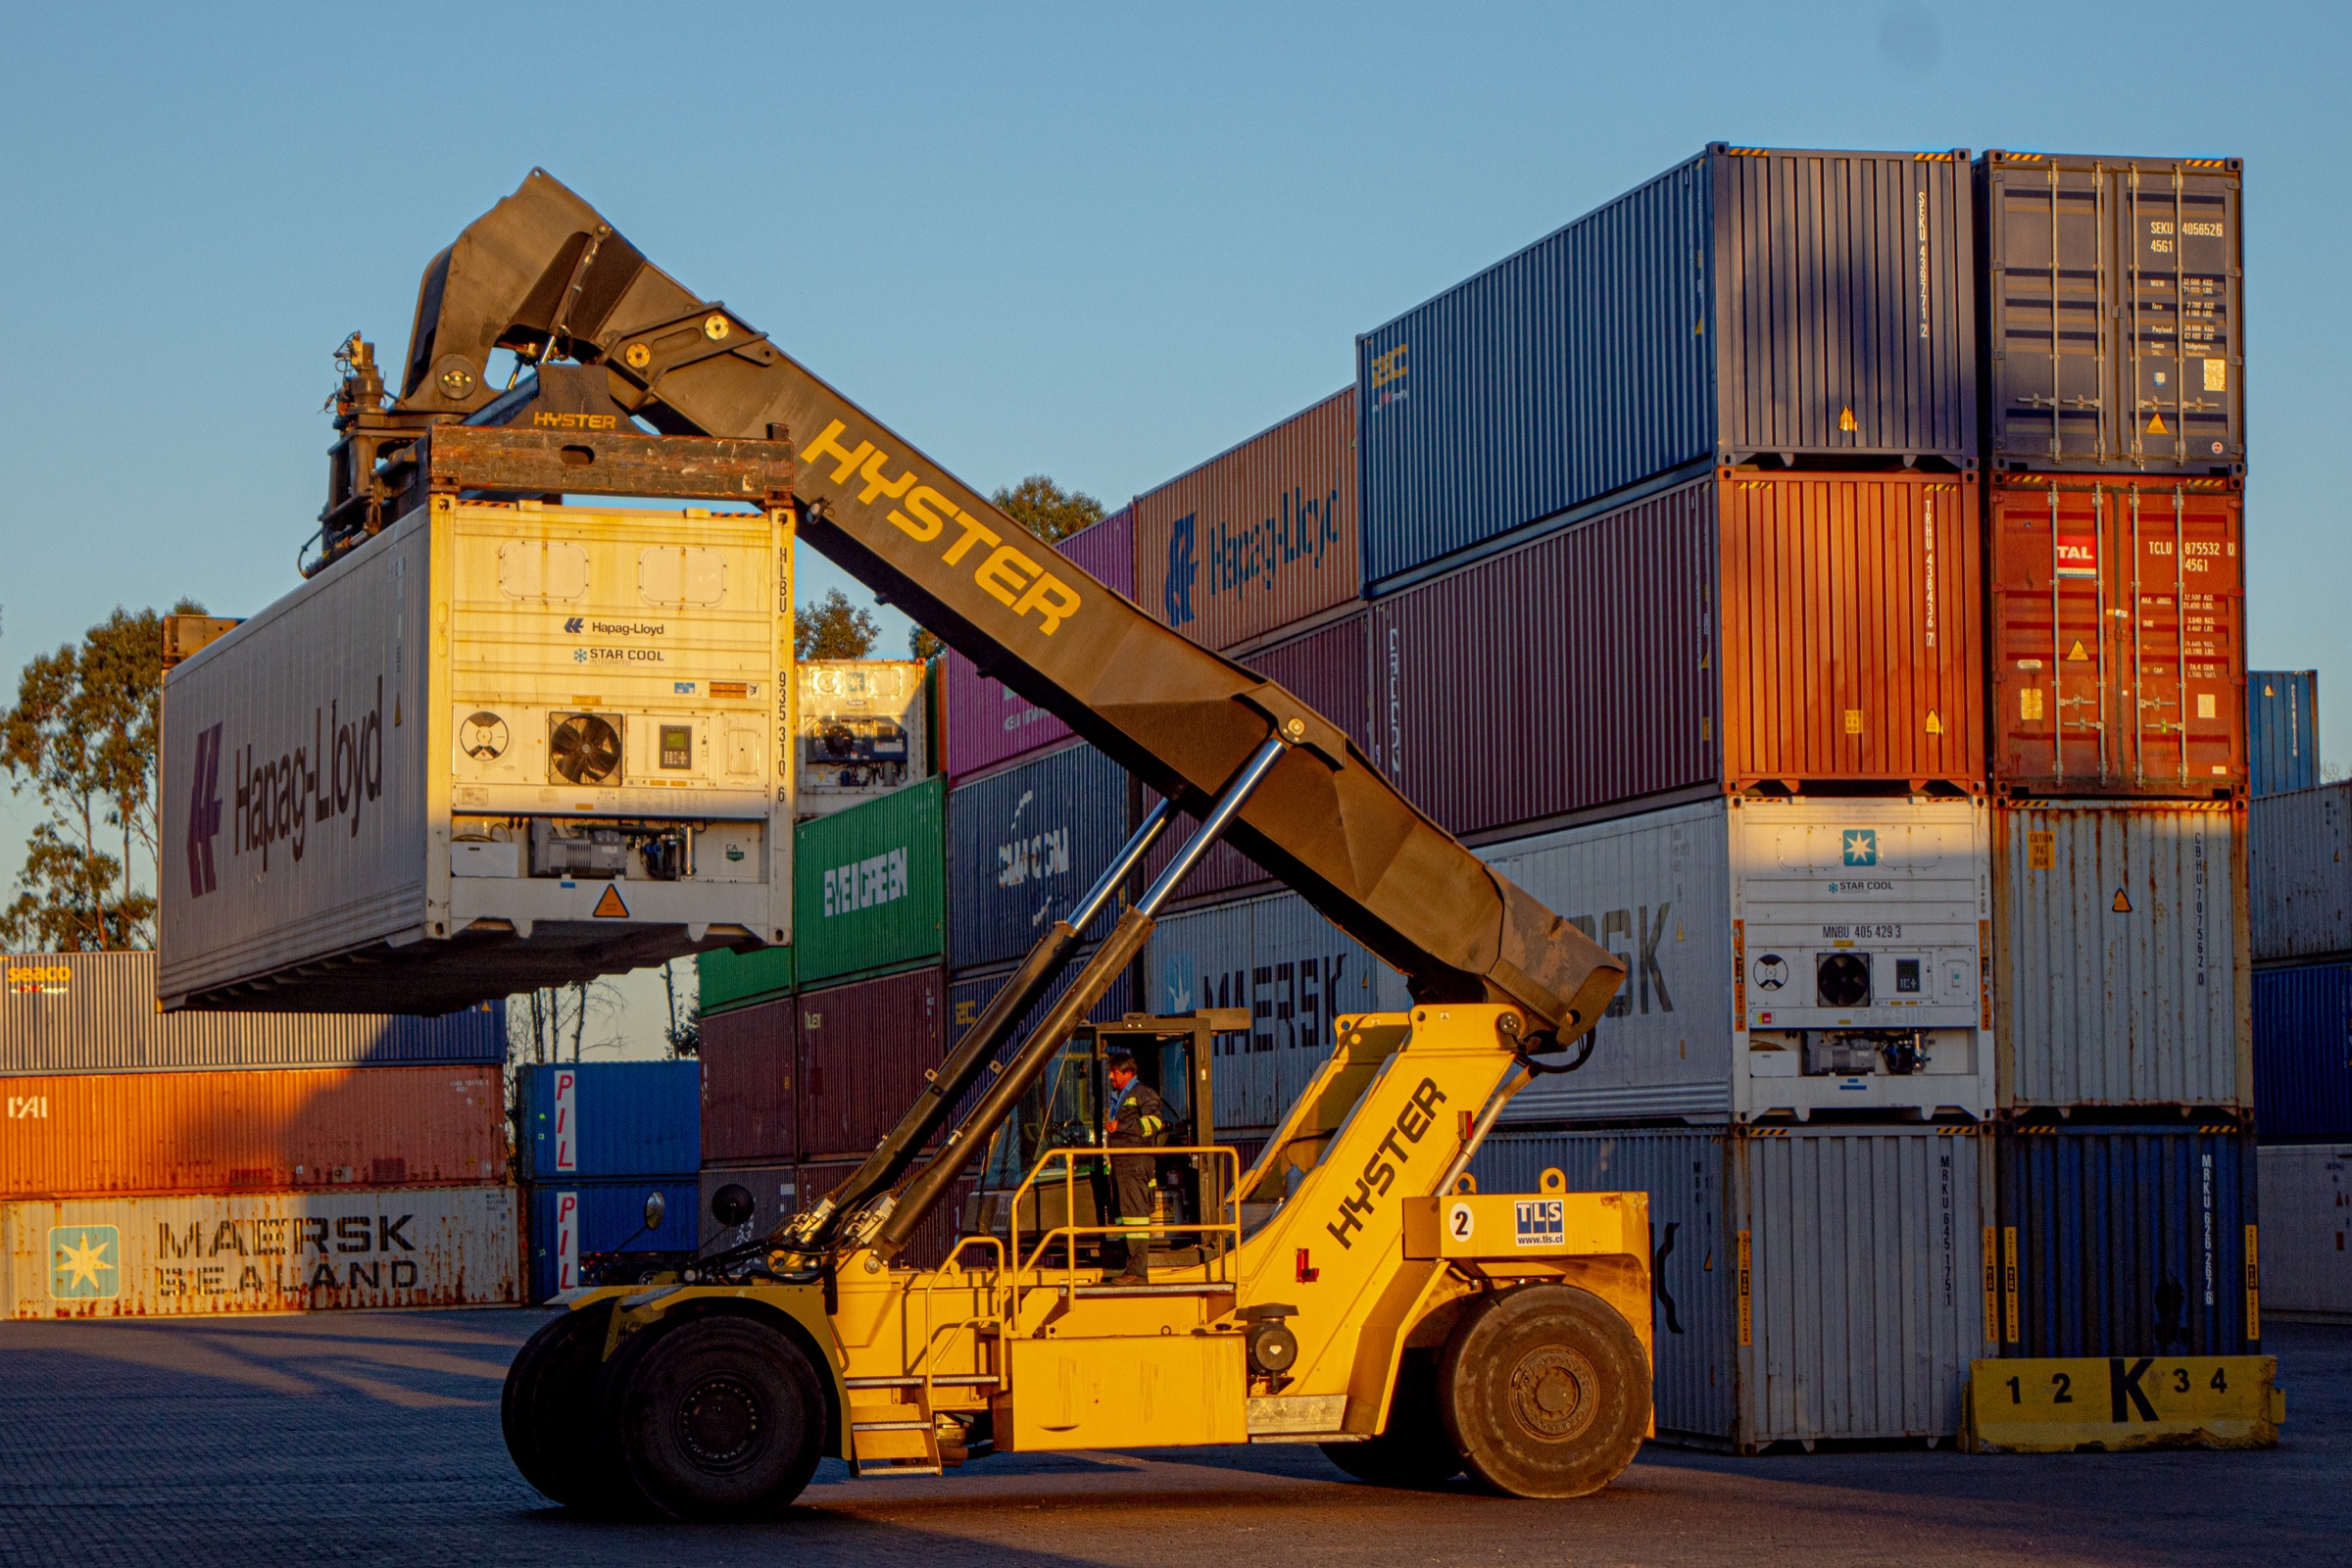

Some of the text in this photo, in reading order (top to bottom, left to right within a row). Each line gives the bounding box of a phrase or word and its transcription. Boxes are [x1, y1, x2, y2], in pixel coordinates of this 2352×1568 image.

[2150, 221, 2174, 234] SEKU
[2150, 239, 2173, 253] 45G1
[2152, 325, 2173, 334] Payload
[533, 412, 617, 429] HYSTER
[800, 417, 1082, 637] HYSTER
[1209, 486, 1341, 601] Hapag-Lloyd
[2057, 546, 2093, 560] TAL
[2148, 541, 2173, 555] TCLU
[2184, 542, 2220, 556] 875532
[2184, 559, 2208, 571] 45G1
[592, 621, 664, 637] Hapag-Lloyd
[590, 648, 664, 662] STAR COOL
[234, 674, 383, 872] Hapag-Lloyd
[2194, 832, 2203, 885] CBHU
[824, 846, 907, 918] EVERGREEN
[1823, 925, 1850, 938] MNBU
[1854, 926, 1872, 938] 405
[1875, 926, 1893, 938] 429
[7, 965, 73, 983] seaco
[1203, 953, 1348, 1057] MAERSK
[556, 1074, 573, 1167] PIL
[1326, 1077, 1447, 1250] HYSTER
[1940, 1154, 1949, 1209] MRKU
[2202, 1154, 2212, 1208] MRKU
[1454, 1210, 1469, 1236] 2
[1517, 1202, 1561, 1222] TLS
[158, 1213, 416, 1259] MAERSK
[558, 1197, 576, 1290] PIL
[1517, 1235, 1563, 1245] www.tls.cl
[159, 1260, 418, 1298] SEALAND
[2005, 1357, 2228, 1423] 1 2 K 3 4
